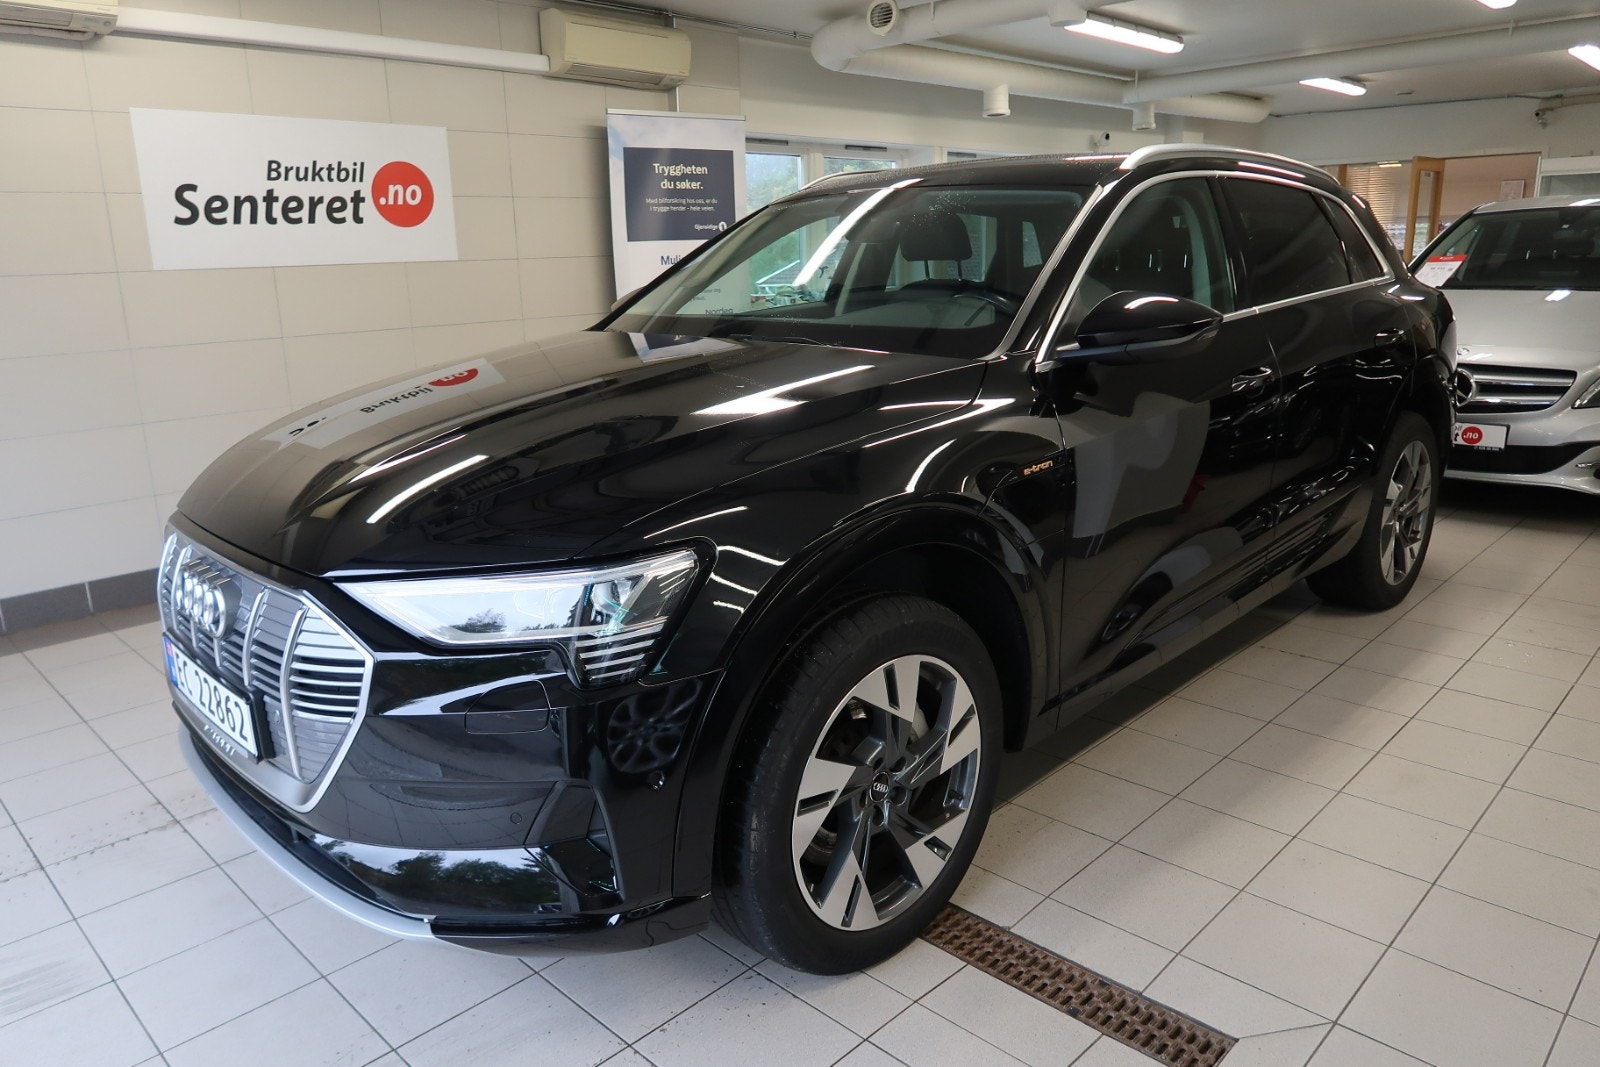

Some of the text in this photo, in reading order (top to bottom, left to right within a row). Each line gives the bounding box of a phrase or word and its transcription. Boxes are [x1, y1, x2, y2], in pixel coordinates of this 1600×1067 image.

[266, 159, 365, 183] Bruktbil
[652, 163, 708, 177] Tryggheten
[660, 178, 704, 190] du søker.
[173, 183, 422, 226] Senteret .no
[1463, 432, 1479, 440] .no
[1023, 460, 1054, 476] e-tron
[194, 669, 249, 743] 22862
